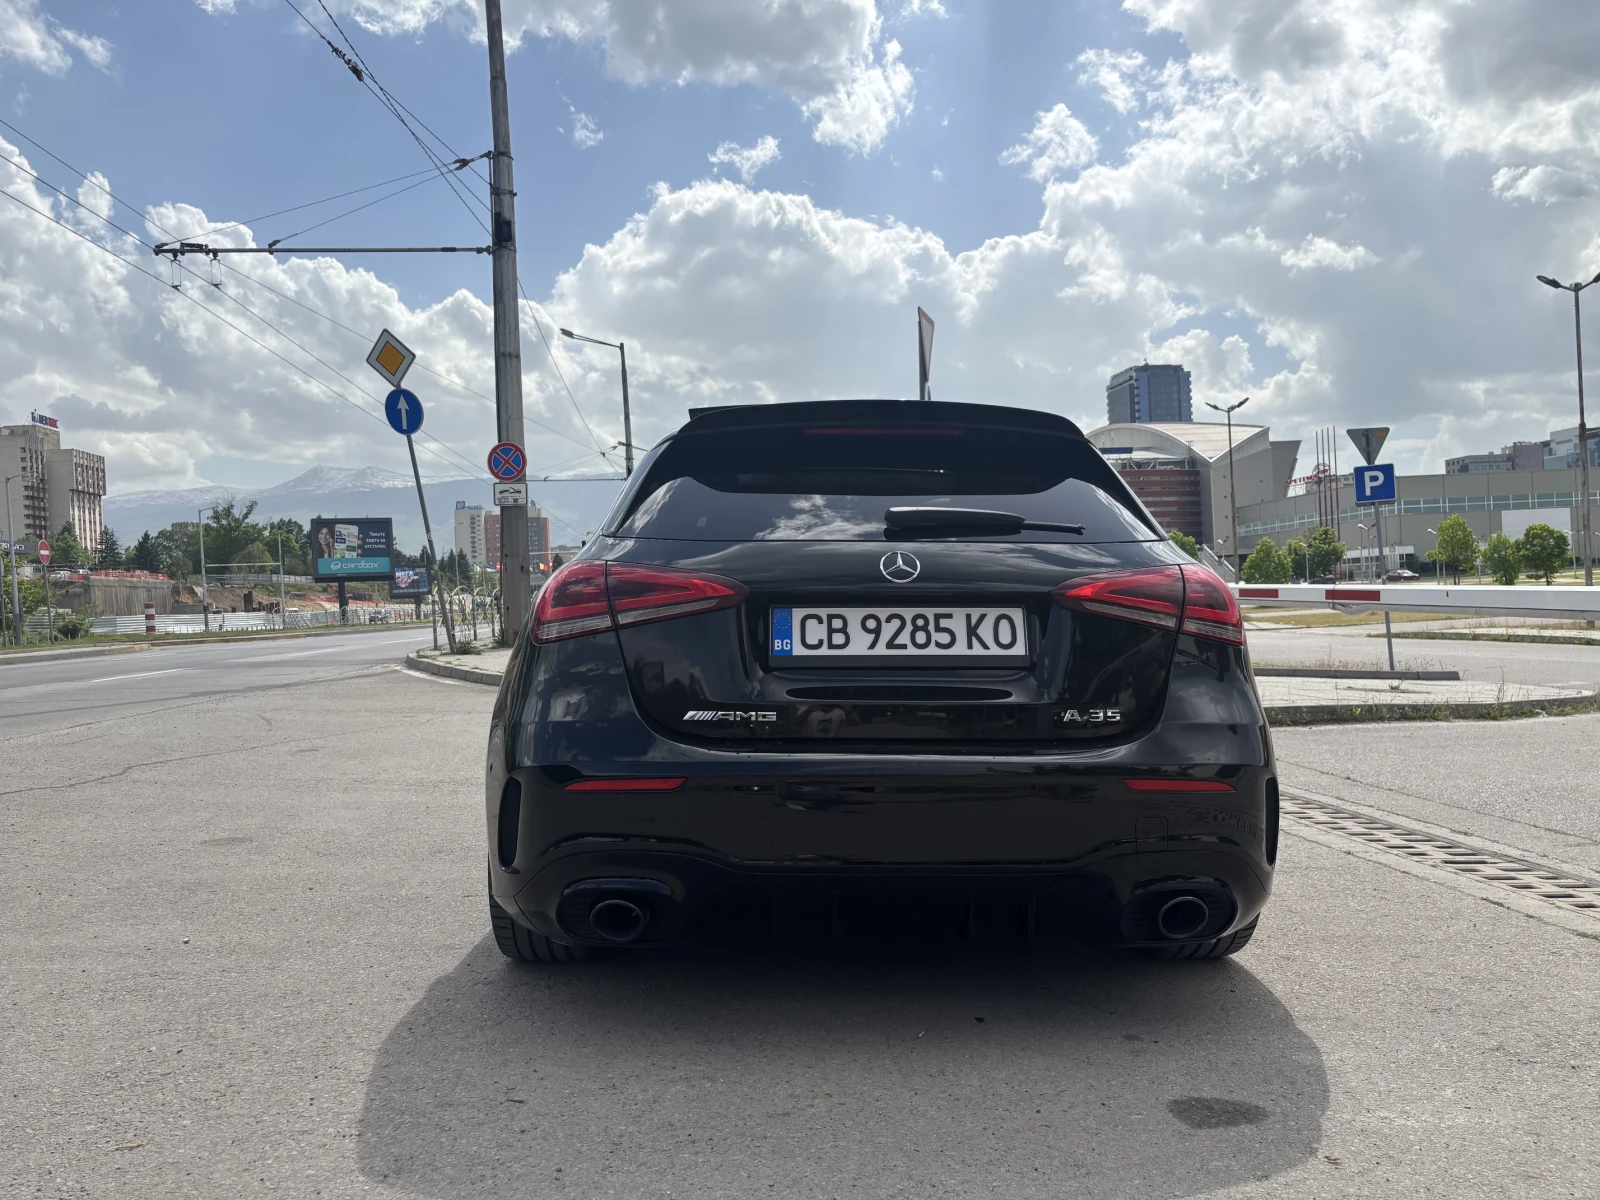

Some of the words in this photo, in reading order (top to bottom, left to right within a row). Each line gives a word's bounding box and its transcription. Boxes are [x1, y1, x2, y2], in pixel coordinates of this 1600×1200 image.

[1363, 470, 1385, 497] P
[342, 560, 379, 569] cardbox
[800, 613, 851, 651] CB
[860, 613, 957, 651] 9285
[965, 613, 1018, 651] KO
[774, 639, 791, 651] BG
[712, 711, 777, 722] AMG
[1063, 709, 1082, 722] A
[1088, 708, 1121, 722] 35
